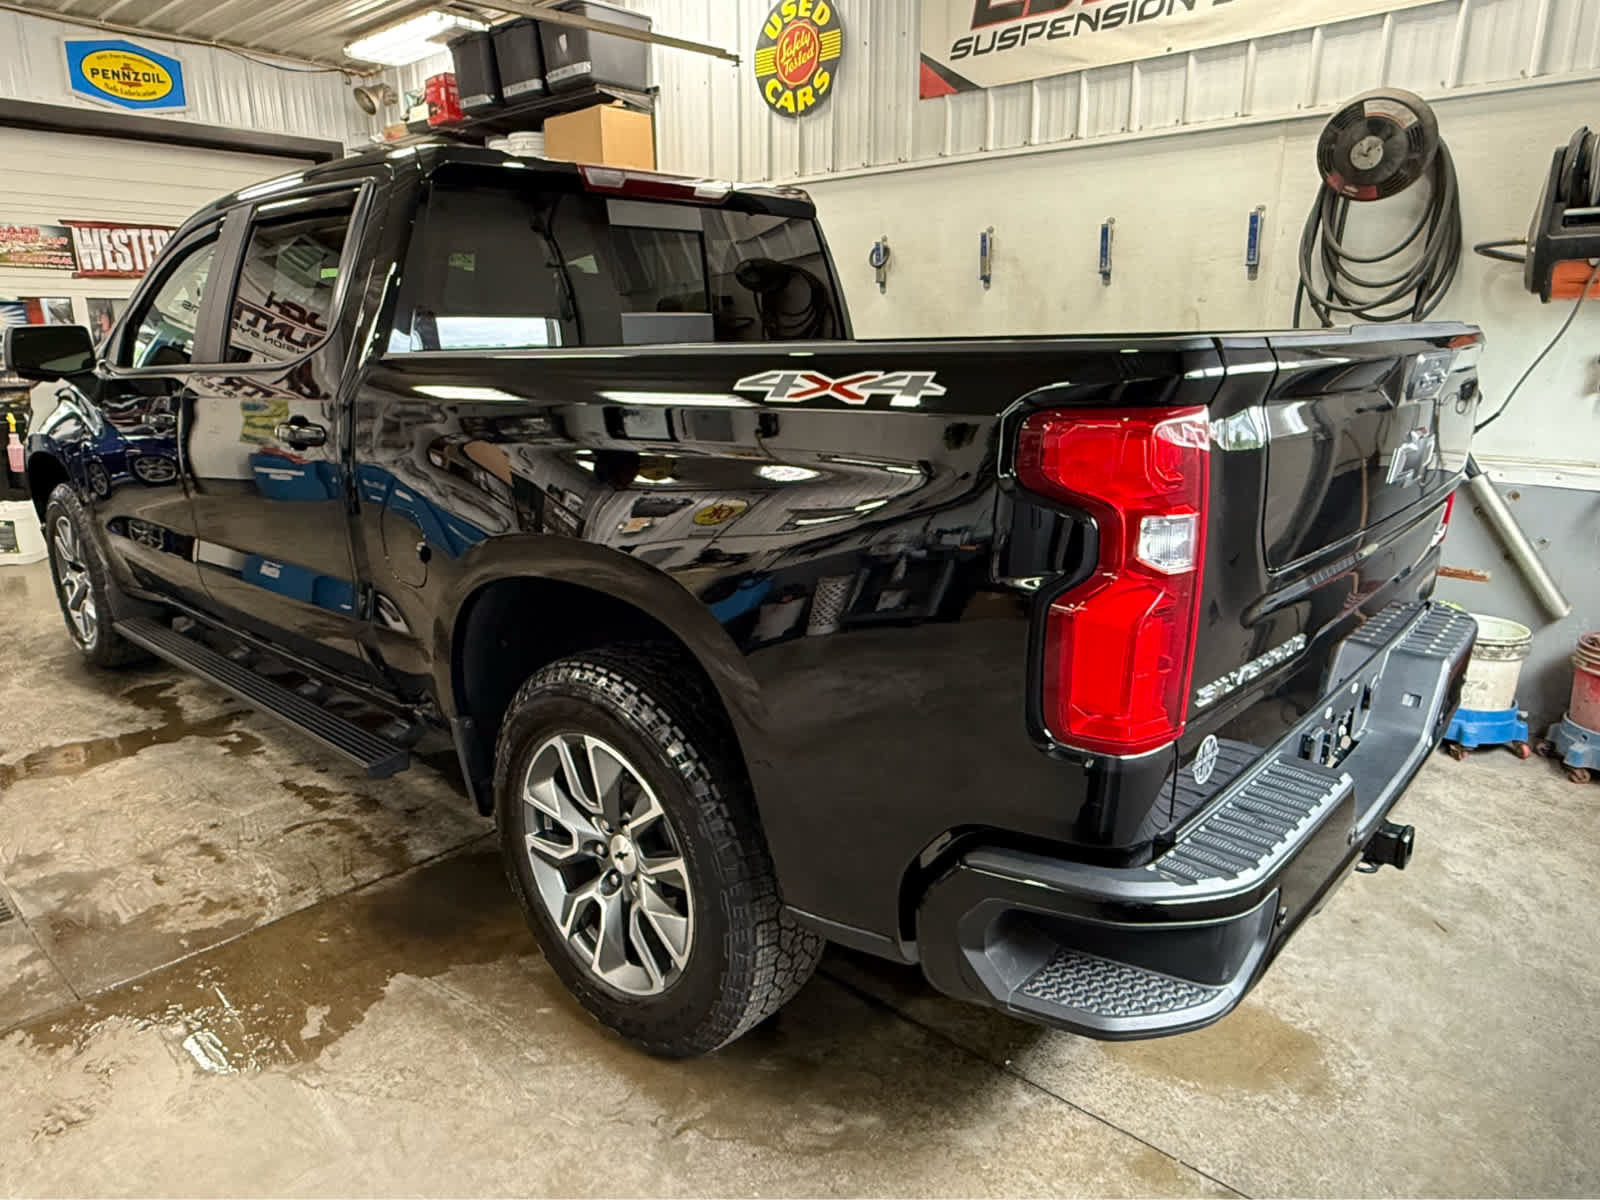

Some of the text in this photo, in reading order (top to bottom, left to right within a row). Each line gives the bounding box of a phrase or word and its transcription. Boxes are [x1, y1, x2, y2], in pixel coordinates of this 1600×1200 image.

[764, 0, 831, 40] USED
[950, 0, 1196, 60] SUSPENSION
[90, 67, 166, 84] PENNZOIL
[765, 67, 831, 113] CARS
[73, 226, 176, 271] WESTER
